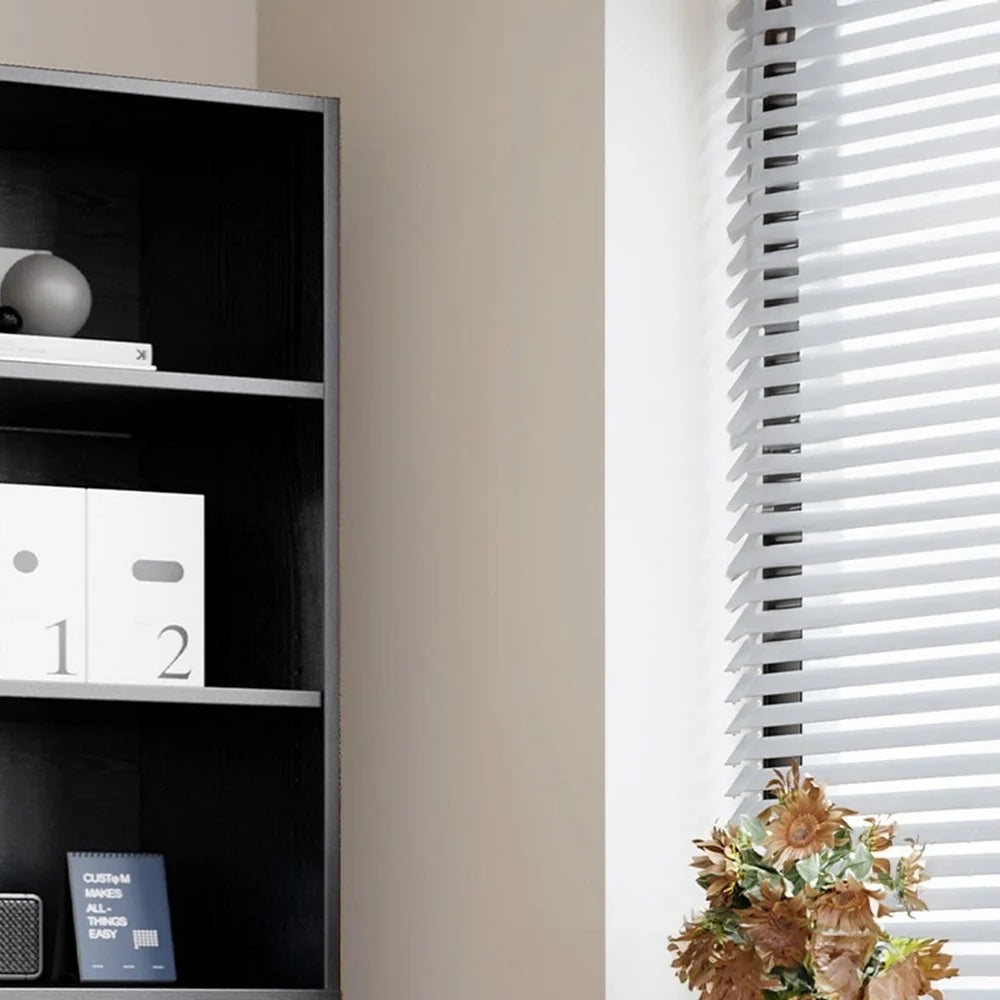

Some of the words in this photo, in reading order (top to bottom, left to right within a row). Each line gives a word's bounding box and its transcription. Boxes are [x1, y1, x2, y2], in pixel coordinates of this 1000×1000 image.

[45, 618, 79, 677] 1
[157, 624, 193, 680] 2
[84, 888, 123, 899] MAKES
[87, 916, 128, 927] THINGS
[88, 929, 118, 940] EASY
